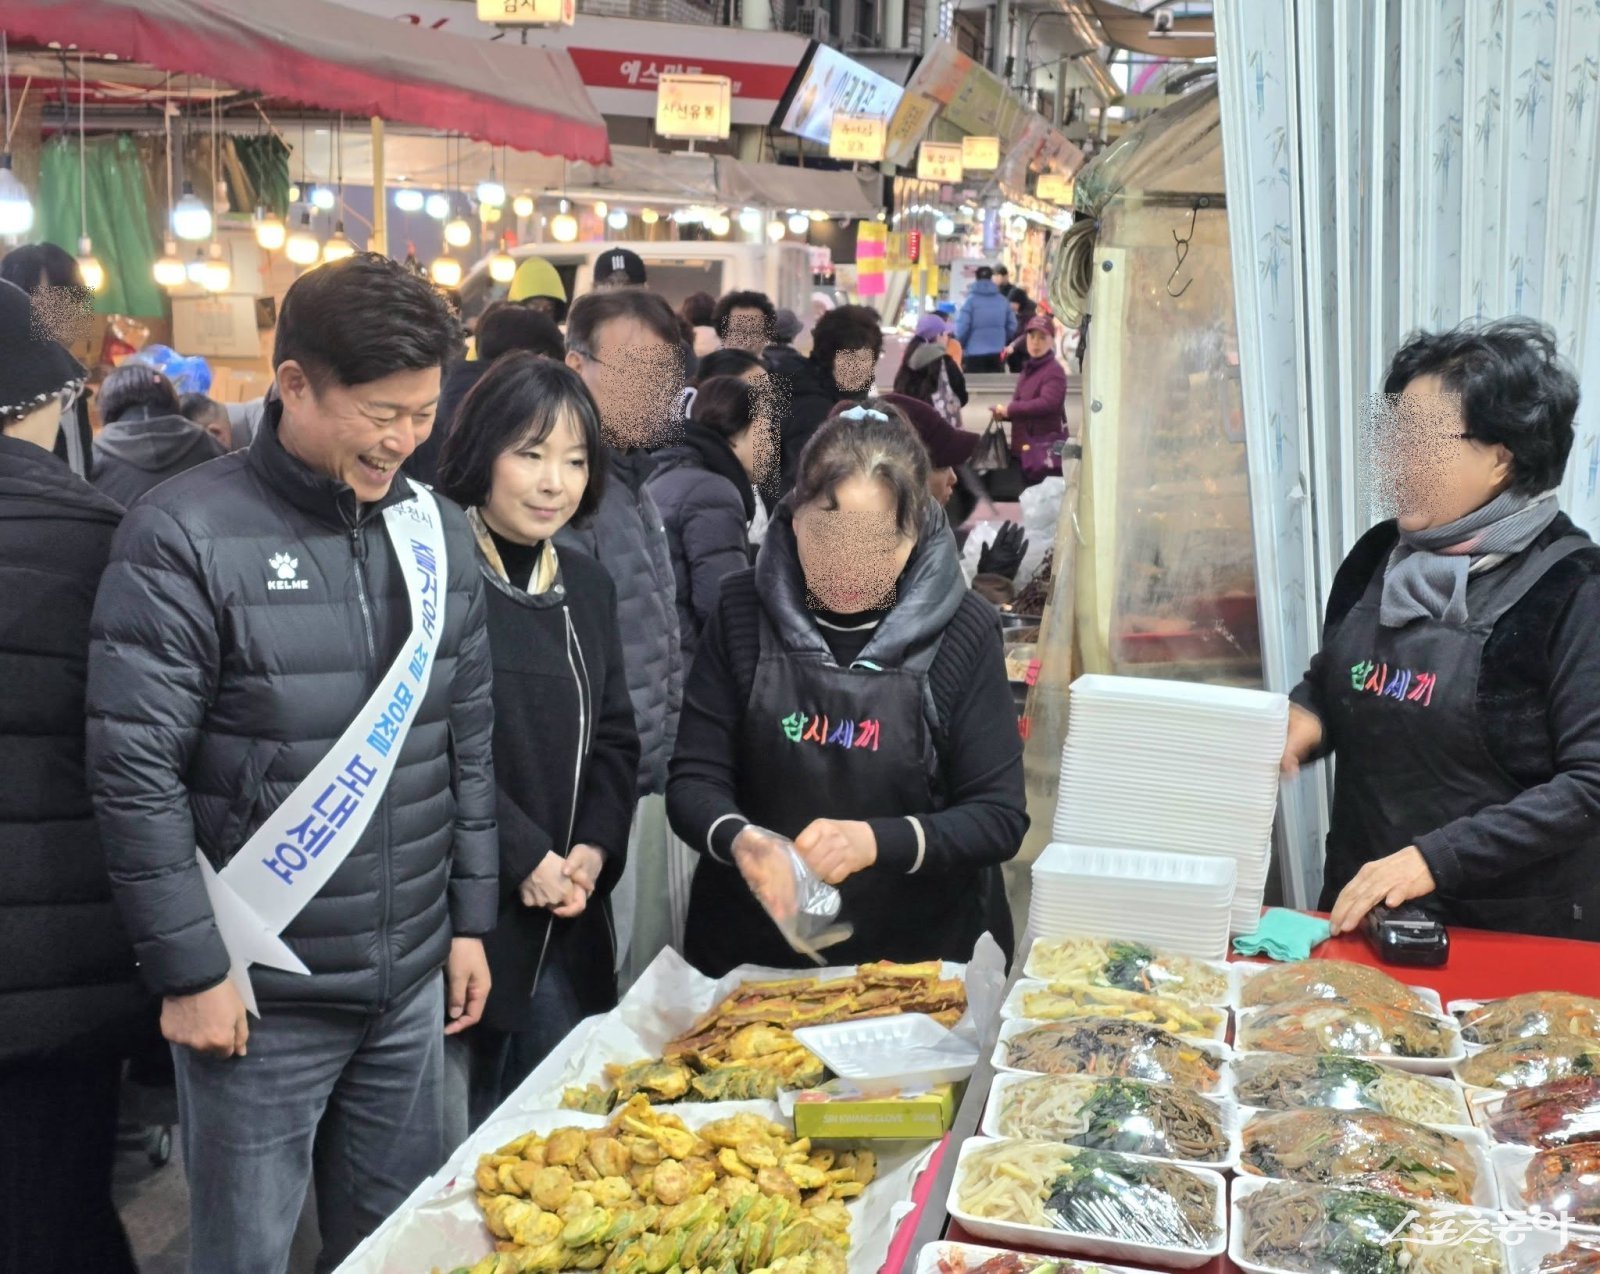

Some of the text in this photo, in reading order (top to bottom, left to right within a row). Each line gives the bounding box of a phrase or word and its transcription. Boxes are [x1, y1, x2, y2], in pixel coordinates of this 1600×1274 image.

[267, 580, 309, 590] KELME
[1351, 659, 1436, 707] 삼시세끼
[262, 537, 441, 886] 즐거운 설 명절 보내세요
[781, 711, 880, 752] 삼시세끼
